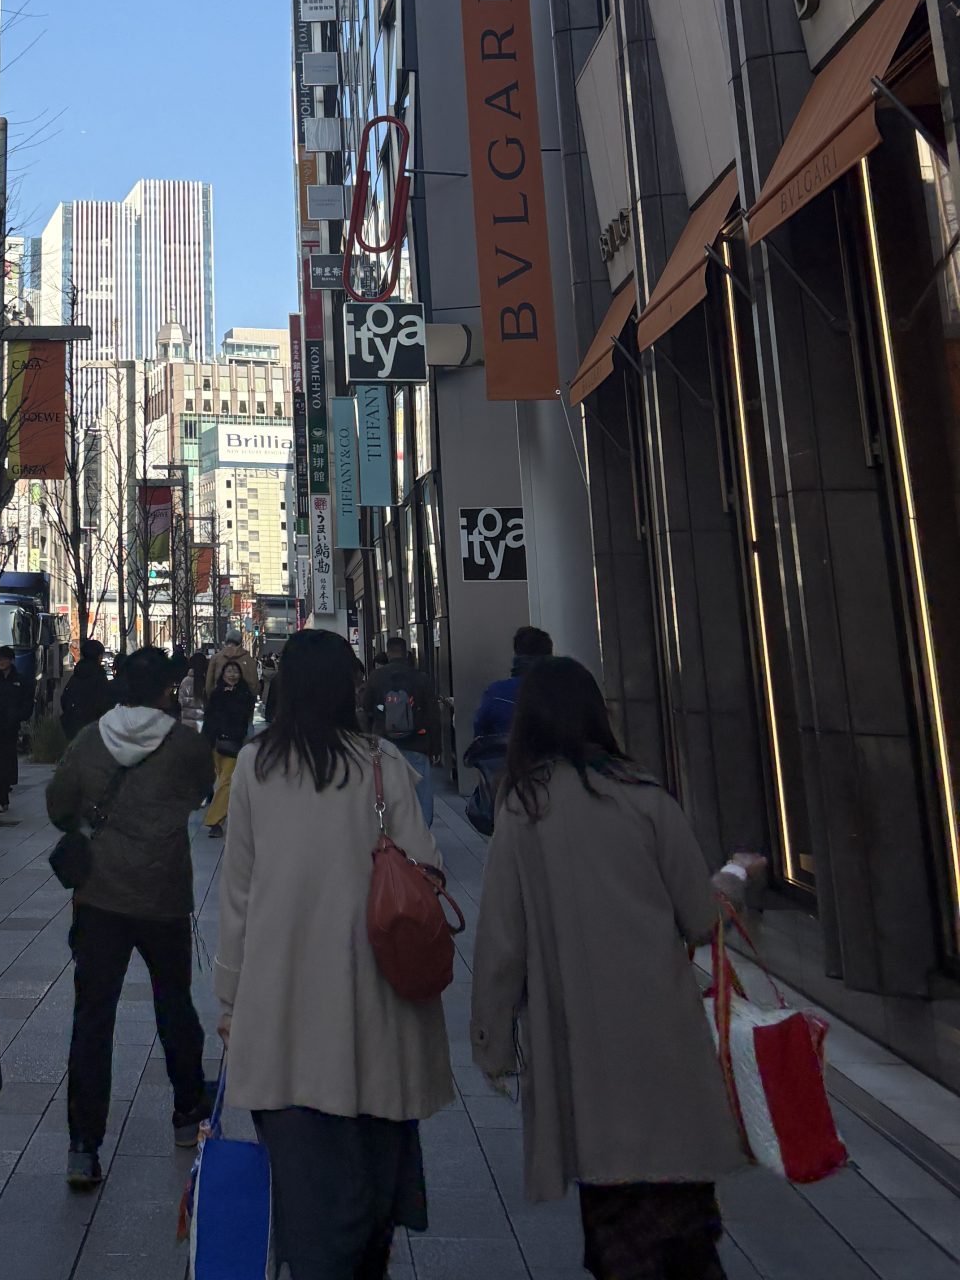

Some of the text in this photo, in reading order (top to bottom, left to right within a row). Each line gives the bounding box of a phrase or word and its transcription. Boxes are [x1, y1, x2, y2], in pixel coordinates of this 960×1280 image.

[779, 147, 839, 216] BVLGARI
[310, 346, 321, 409] KOMEHYO
[226, 433, 293, 449] Brillia
[312, 444, 325, 482] 珈琲館
[314, 511, 330, 574] うまい鮨勘
